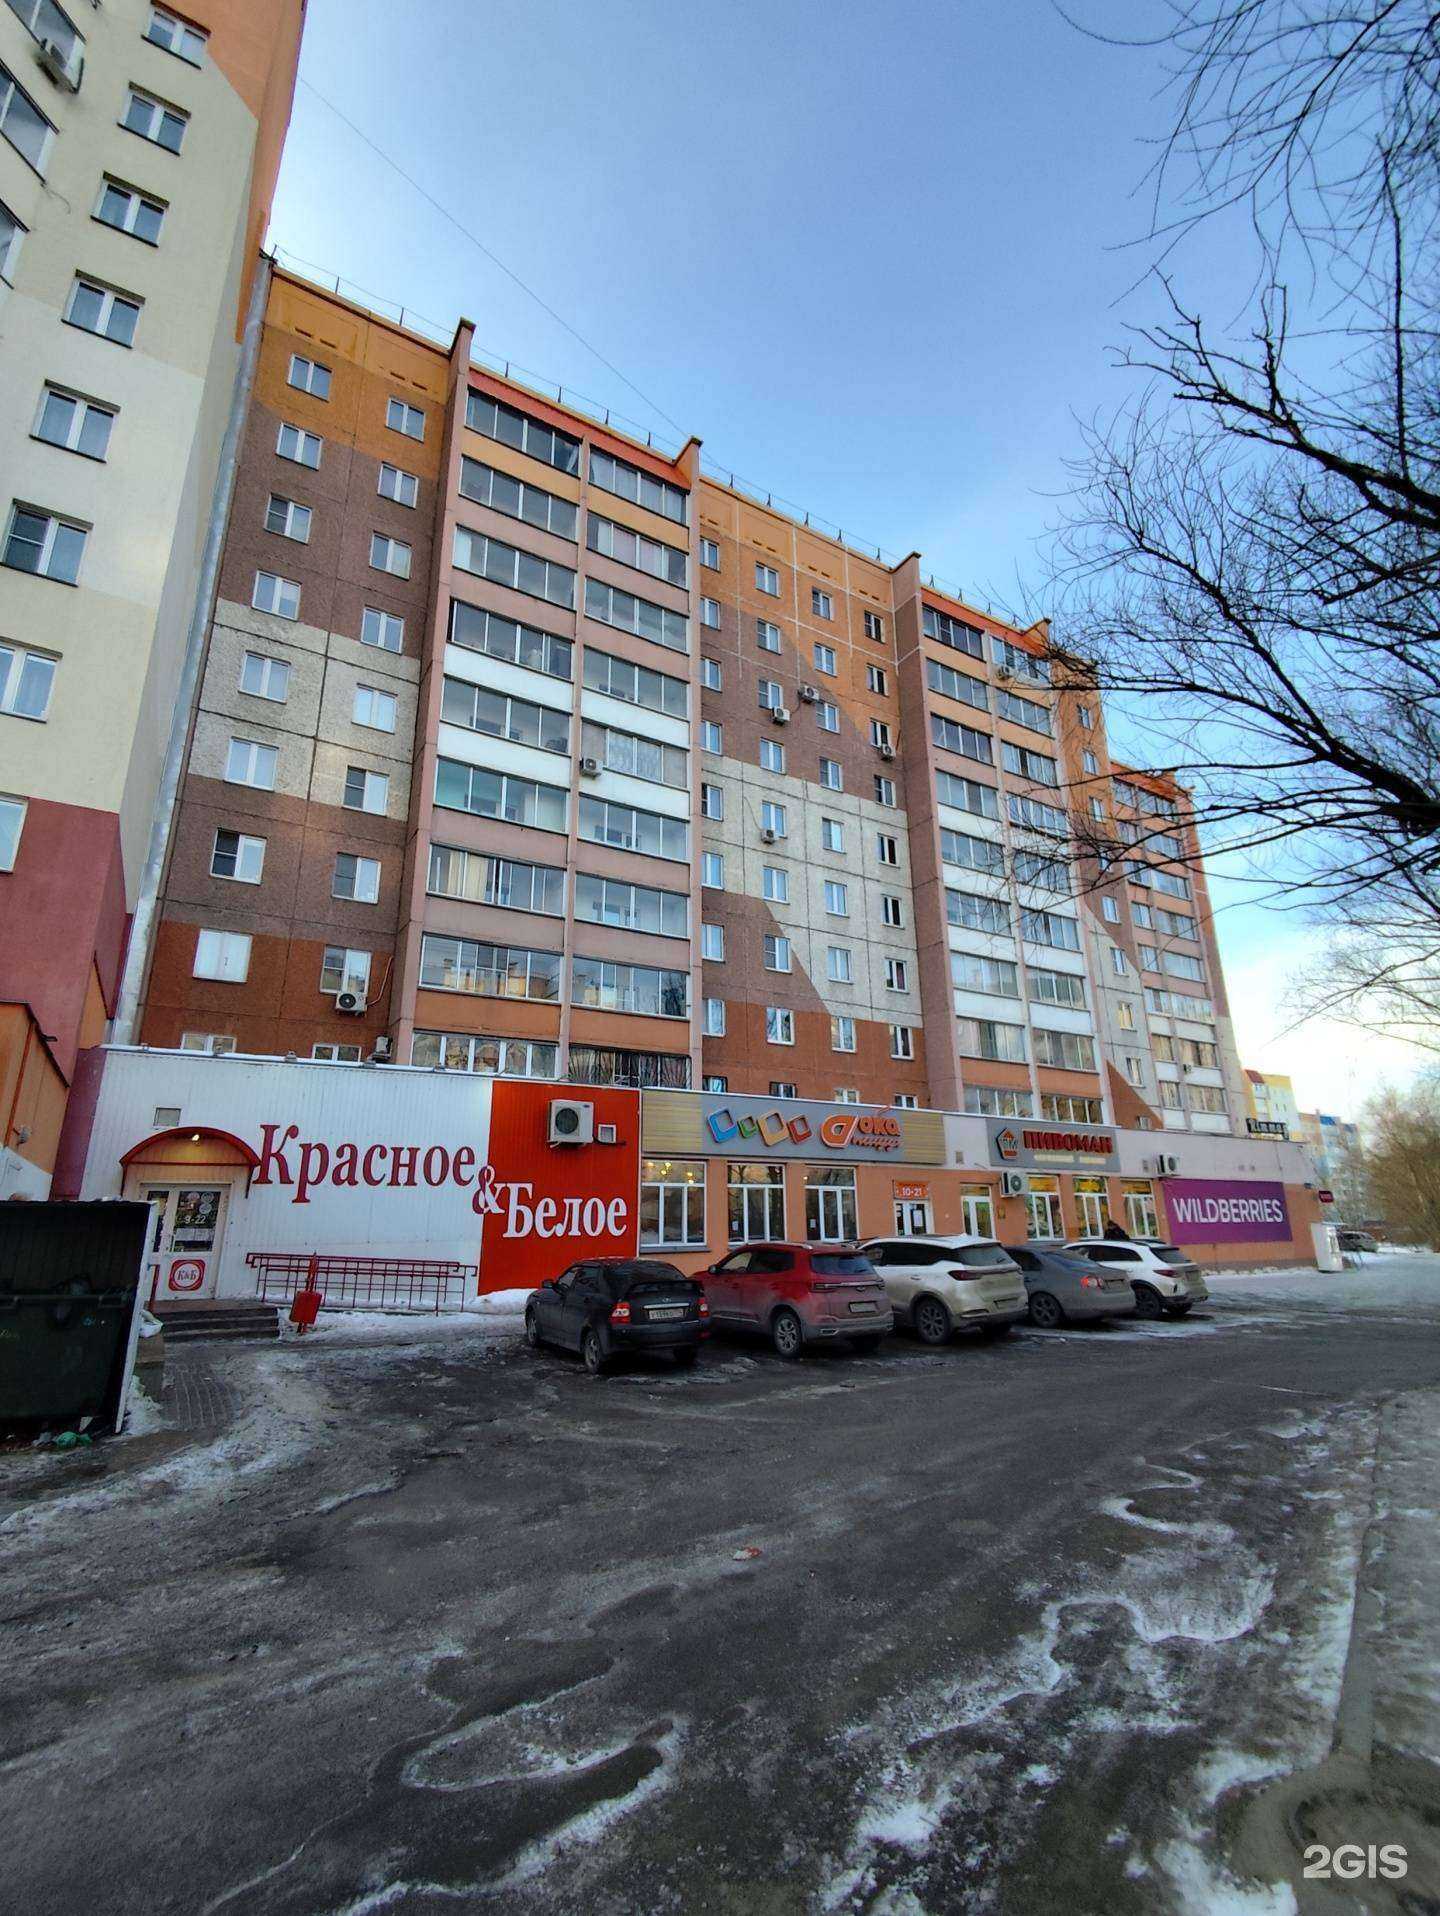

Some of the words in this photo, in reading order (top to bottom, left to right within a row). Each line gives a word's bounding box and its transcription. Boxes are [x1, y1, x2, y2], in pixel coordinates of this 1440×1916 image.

[1022, 1130, 1112, 1153] ПИВОМАН
[252, 1124, 476, 1203] Красное
[503, 1183, 627, 1238] Белое
[1172, 1198, 1283, 1223] WILDBERRIES
